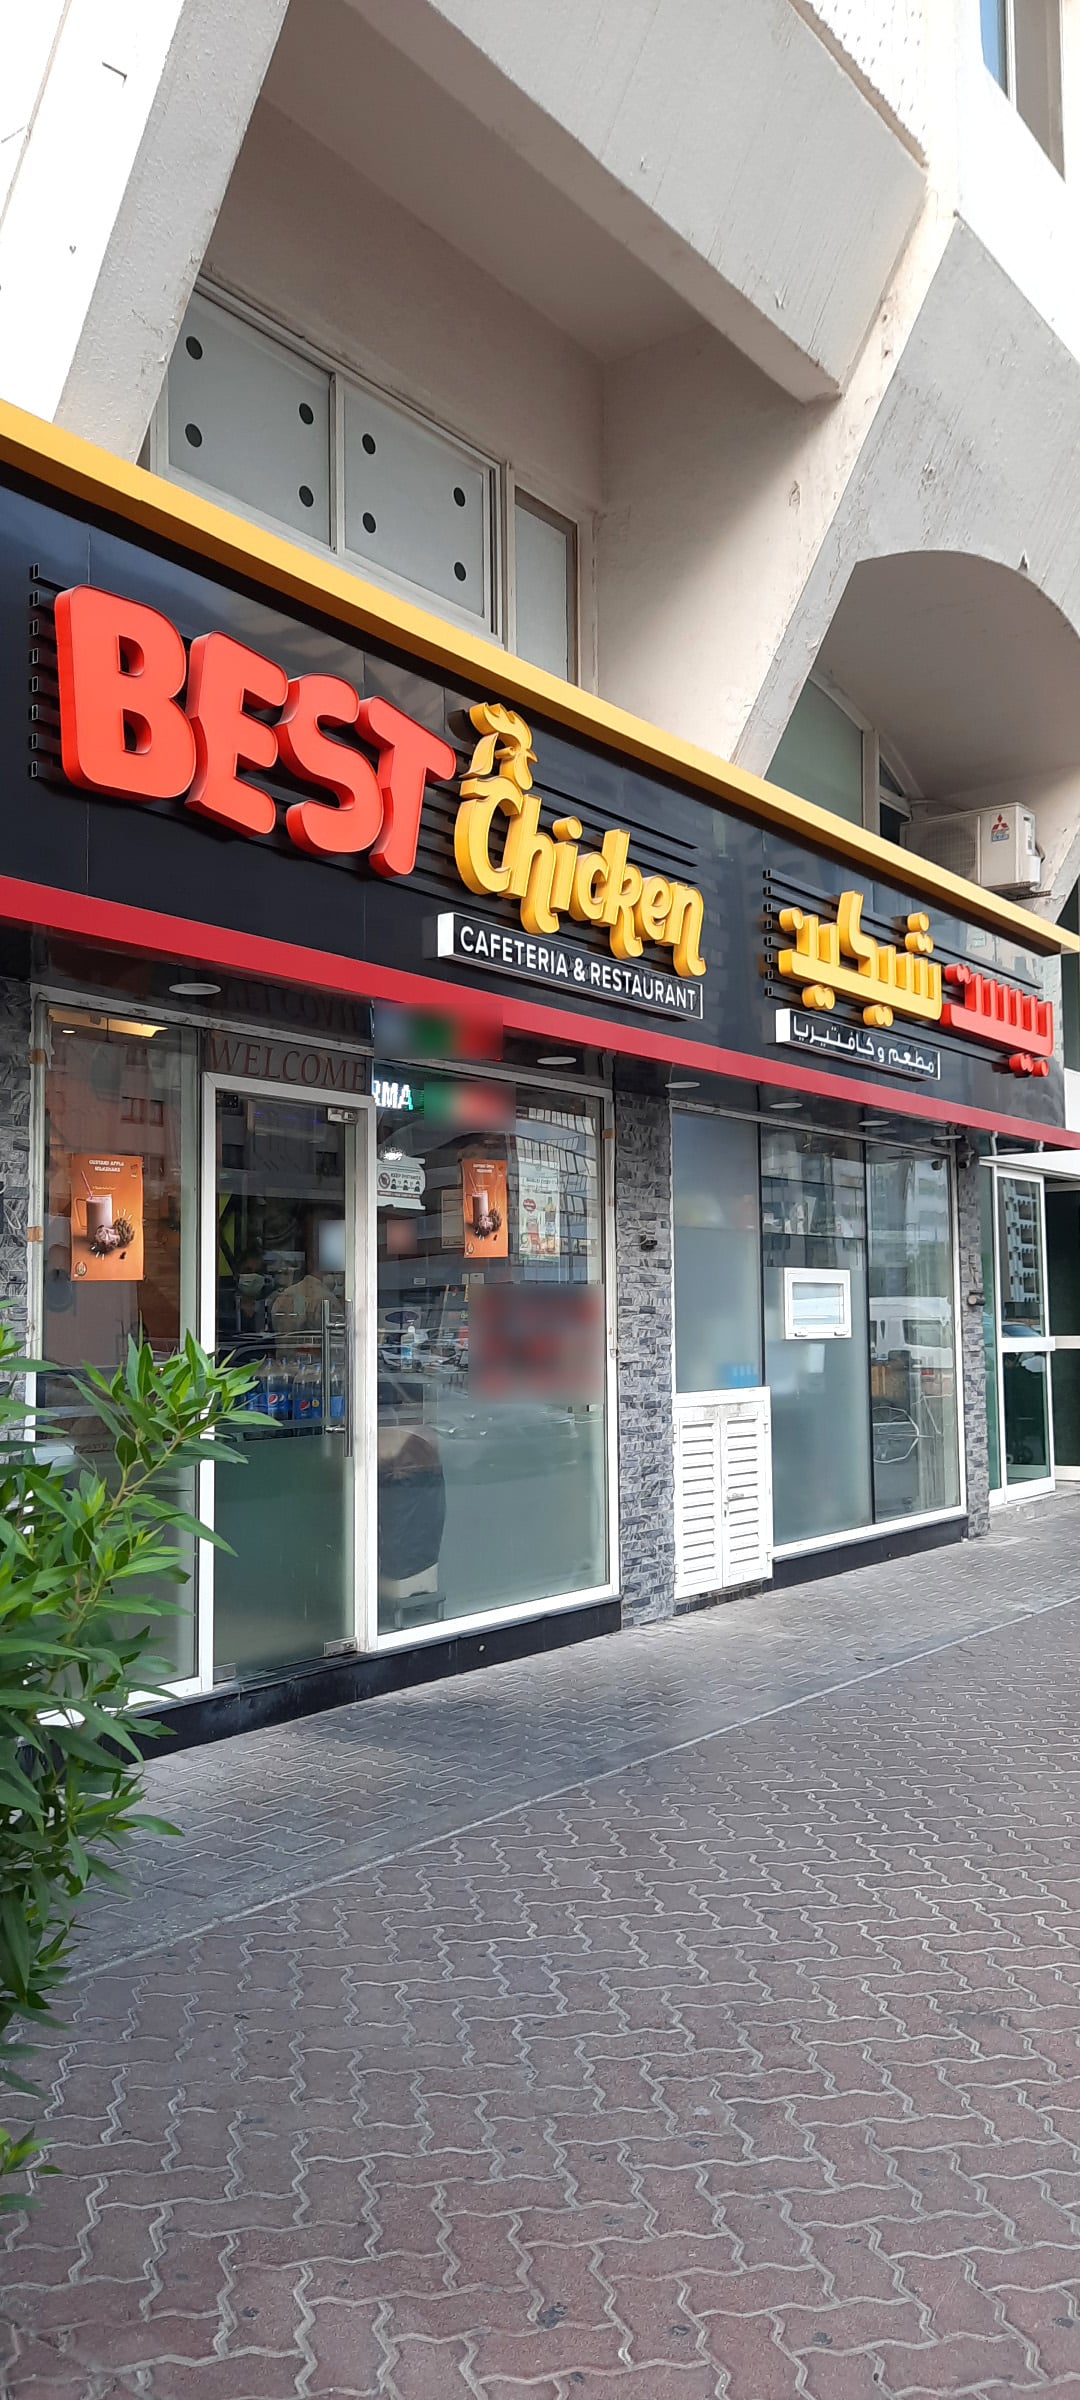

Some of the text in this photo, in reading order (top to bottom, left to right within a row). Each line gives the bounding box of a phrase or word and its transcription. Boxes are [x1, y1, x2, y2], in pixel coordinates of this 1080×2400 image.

[54, 584, 707, 978] BEST Chicken
[459, 925, 697, 1011] CAFETERIA & RESTAURANT
[793, 1015, 935, 1074] مطعم و كافتيريا
[940, 964, 1053, 1077] بيست
[208, 1037, 367, 1092] WELCOME
